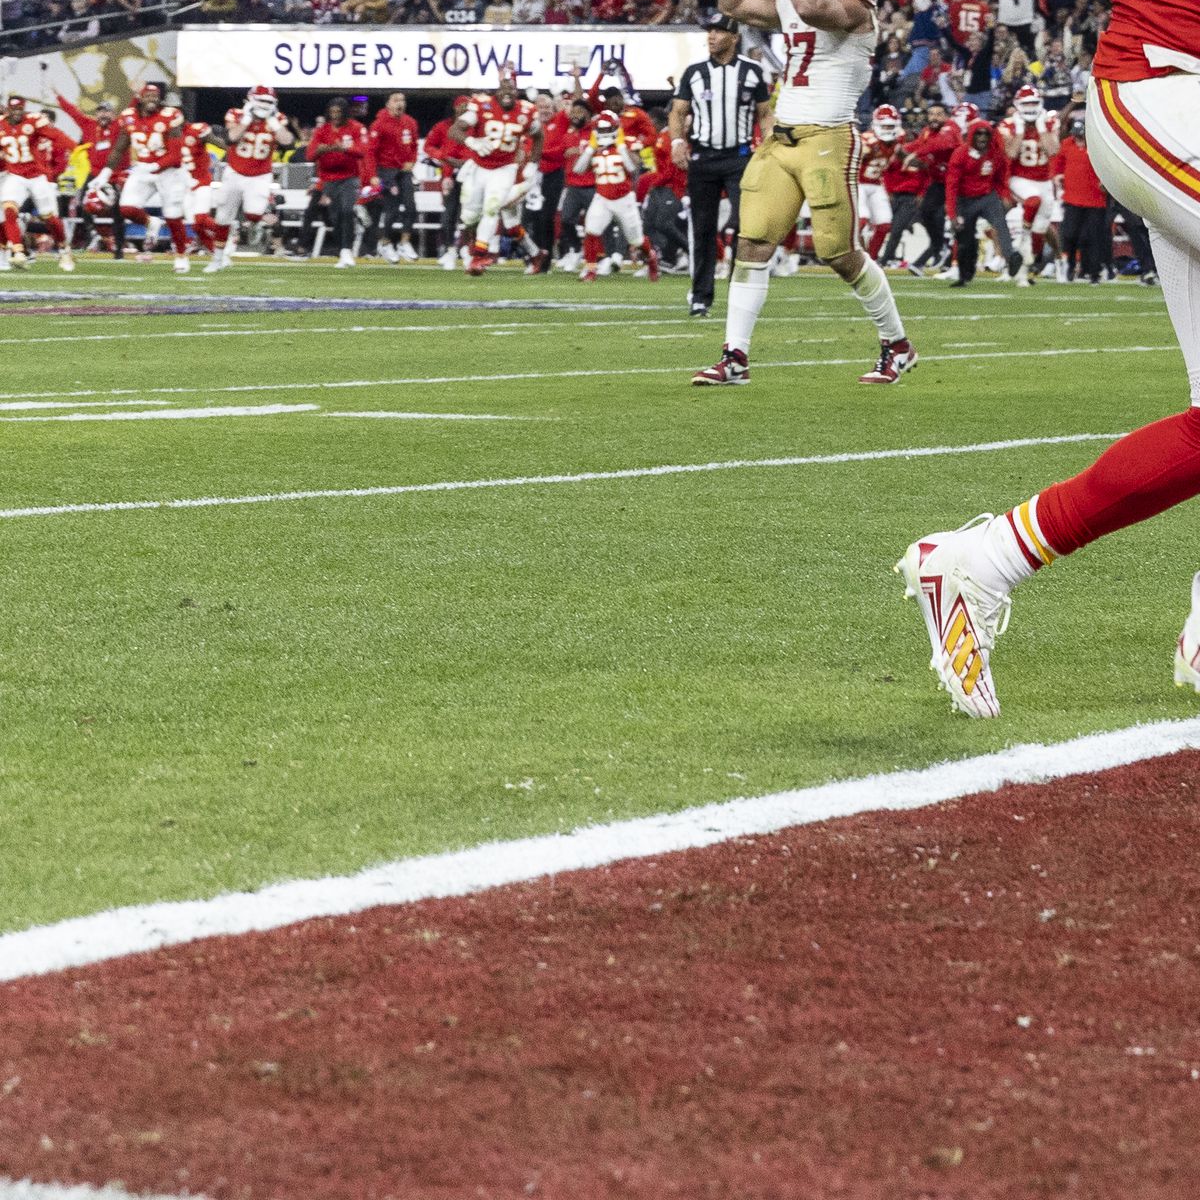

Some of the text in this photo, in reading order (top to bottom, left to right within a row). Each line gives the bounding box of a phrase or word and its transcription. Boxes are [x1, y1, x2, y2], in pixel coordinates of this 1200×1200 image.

[274, 43, 393, 76] SUPER
[417, 43, 533, 77] BOWL
[783, 31, 817, 87] 7
